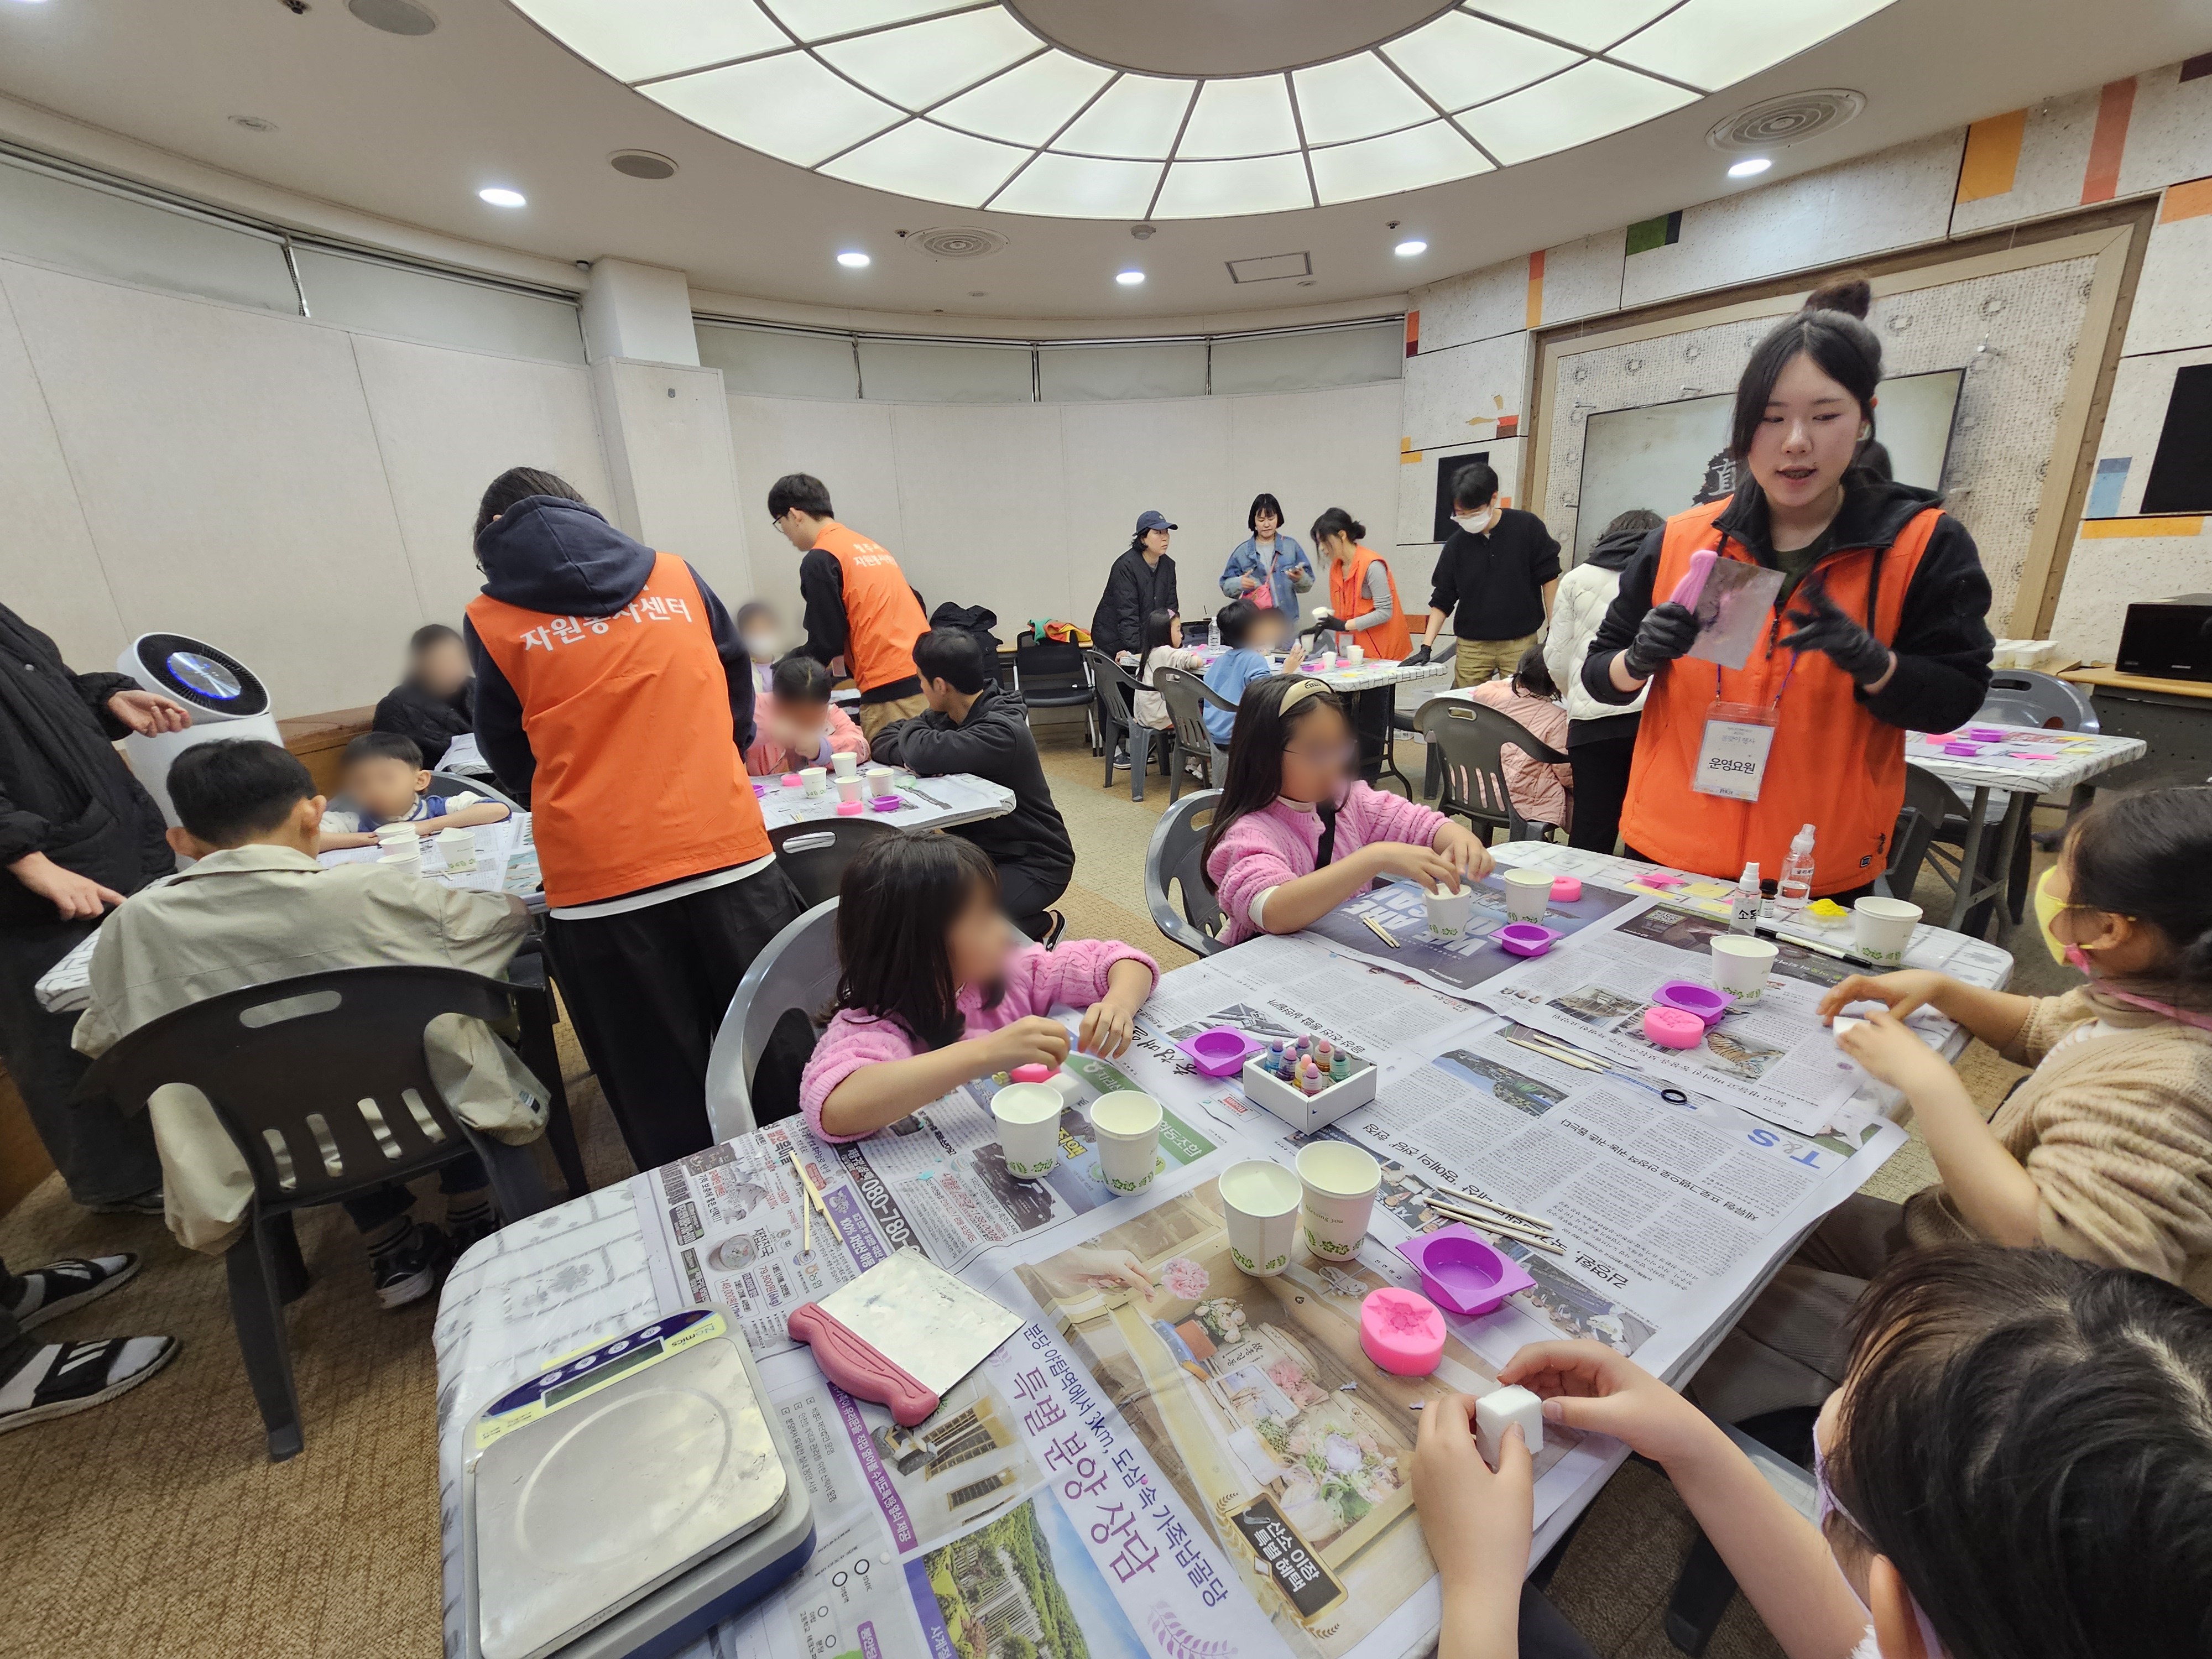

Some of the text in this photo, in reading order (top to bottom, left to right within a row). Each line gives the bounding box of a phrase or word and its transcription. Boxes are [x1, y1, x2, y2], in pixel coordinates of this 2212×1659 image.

[1709, 758, 1755, 775] 운영요원
[1300, 1014, 1323, 1033] 통합
[1132, 1026, 1196, 1074] 충청매일
[1360, 1120, 1391, 1144] 헌정
[1559, 1116, 1589, 1137] 돕는다
[1627, 1152, 1660, 1175] 안정적
[1660, 1167, 1724, 1206] 프로그램으로
[1305, 1204, 1329, 1223] Blessing
[1722, 1199, 1759, 1223] 체류형
[749, 1226, 775, 1259] 재첩진국
[838, 1216, 875, 1269] 100% 자연산 하동
[807, 1271, 823, 1290] 농협
[1570, 1248, 1630, 1291] 김영환,
[671, 1324, 714, 1348] Nomics
[784, 1417, 800, 1439] 분당에서
[842, 1405, 863, 1436] 유리문을
[791, 1437, 806, 1456] 유일한
[823, 1441, 836, 1455] 운영
[854, 1433, 870, 1451] 직접
[815, 1460, 828, 1475] 위한
[860, 1447, 880, 1473] 열어볼
[1021, 1321, 1052, 1354] 분당
[1039, 1344, 1097, 1418] 야탑역에서
[1081, 1409, 1122, 1456] 3km,
[1108, 1447, 1147, 1491] 도심
[1146, 1501, 1232, 1611] 가족납골당
[806, 1480, 820, 1494] 시설
[999, 1361, 1167, 1591] 특별 분양 상담
[893, 1520, 913, 1544] 제공
[1251, 1526, 1307, 1594] 특별 혜택
[1265, 1517, 1321, 1584] 산소 이장
[861, 1574, 873, 1592] 성남IC
[814, 1639, 826, 1653] 분당
